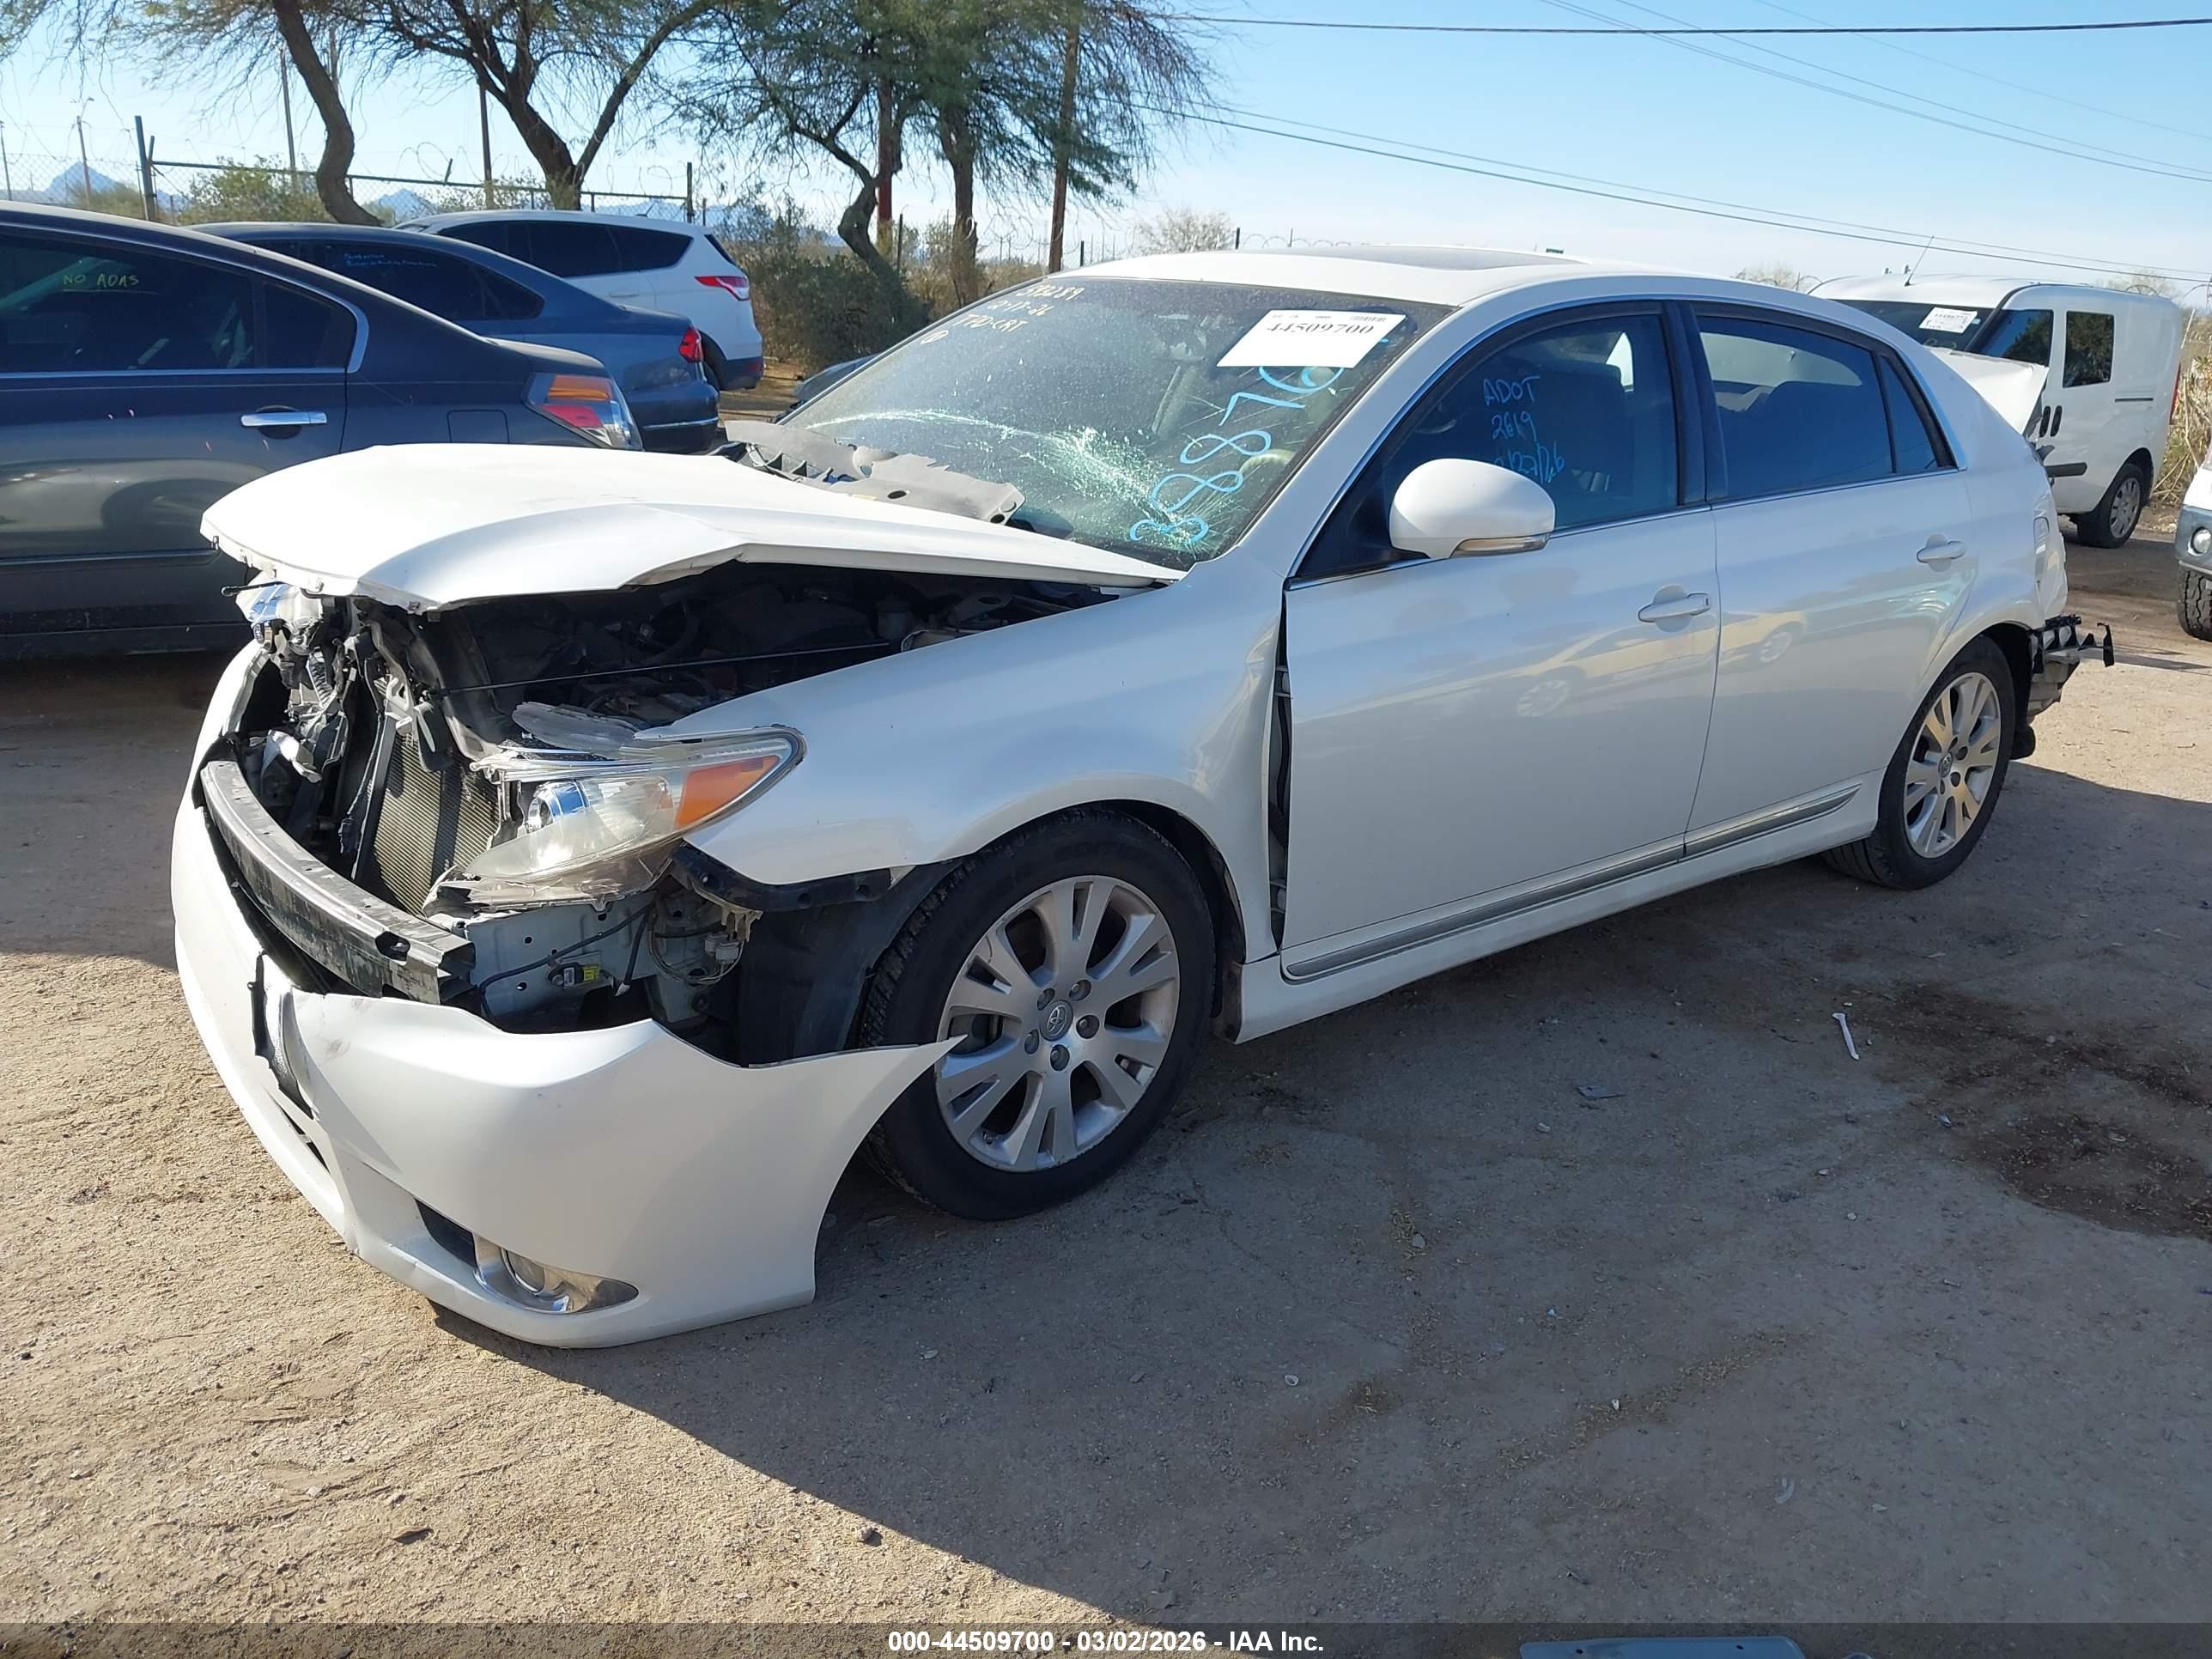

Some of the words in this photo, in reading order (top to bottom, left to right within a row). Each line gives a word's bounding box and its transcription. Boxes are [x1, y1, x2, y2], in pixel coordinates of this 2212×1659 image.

[63, 274, 87, 285] NO
[1266, 322, 1376, 336] 44509700
[1483, 375, 1541, 406] ADOT
